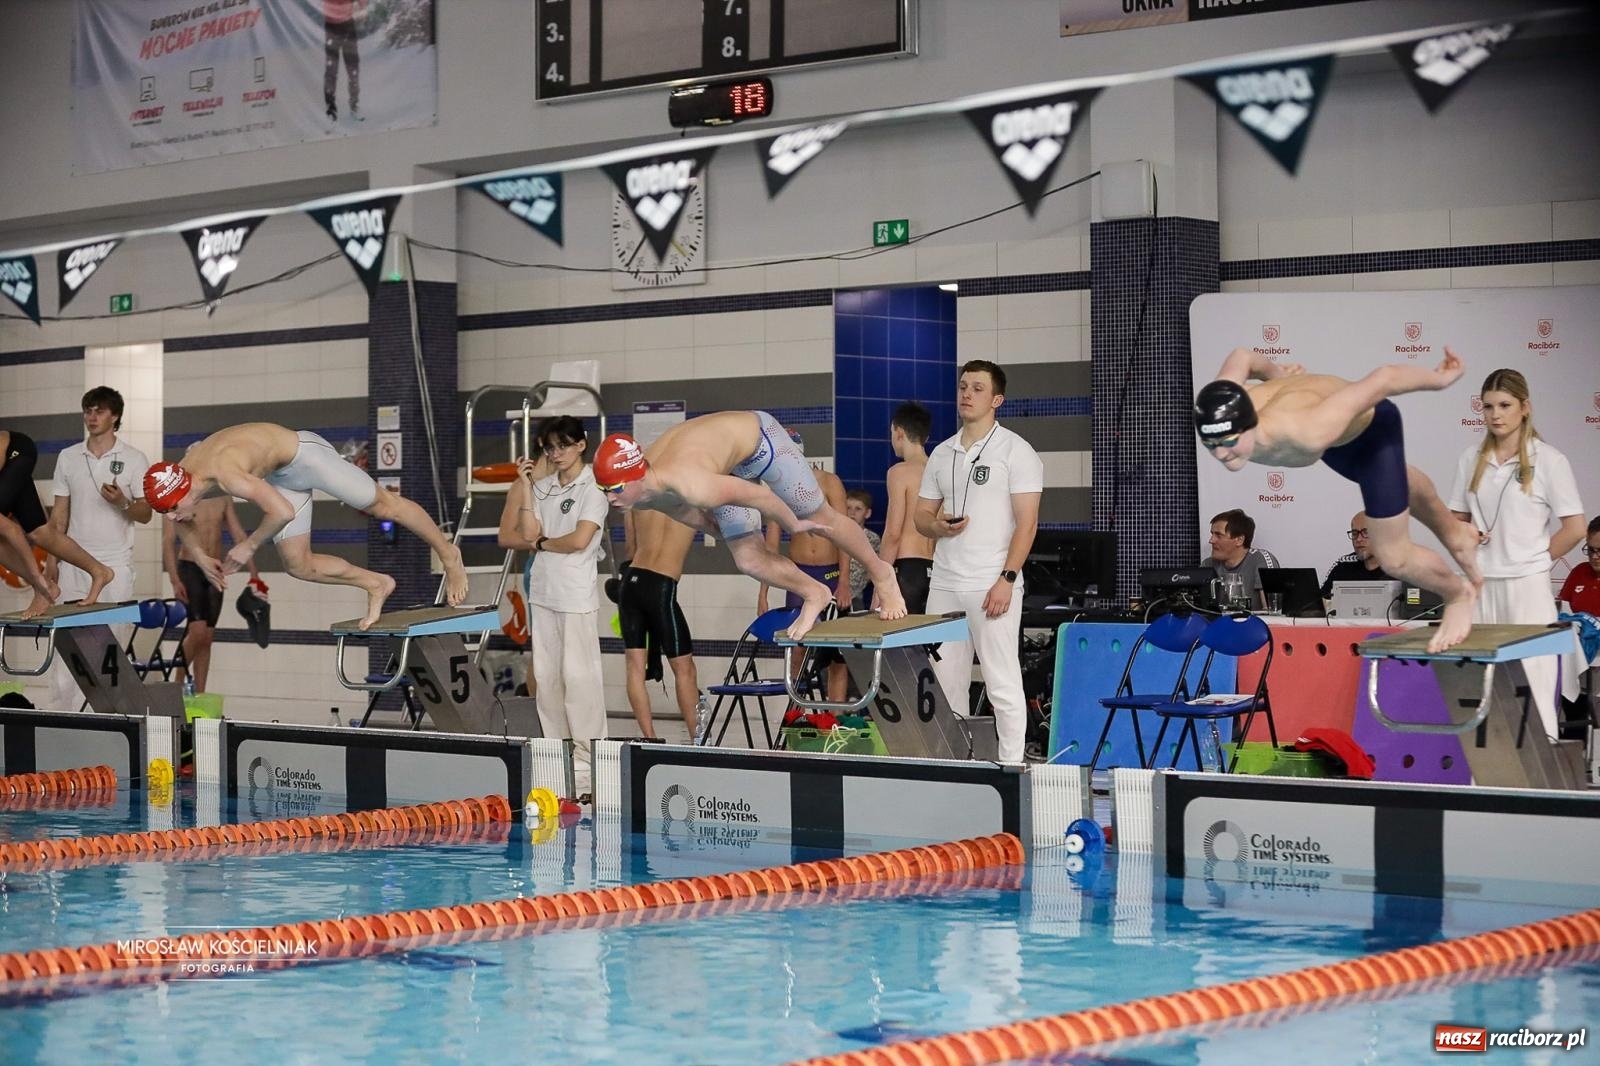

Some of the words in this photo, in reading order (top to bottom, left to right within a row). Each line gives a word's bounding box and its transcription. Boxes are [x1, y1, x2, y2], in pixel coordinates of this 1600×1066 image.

[546, 23, 565, 43] 3.
[722, 36, 742, 58] 8.
[545, 62, 565, 83] 4.
[729, 82, 766, 115] 18
[331, 208, 384, 237] arena
[198, 227, 246, 256] arena
[1395, 345, 1431, 353] Racibórz
[1201, 421, 1232, 434] arena
[1258, 494, 1294, 502] Racibórz
[101, 644, 119, 687] 4
[409, 666, 442, 704] 5
[450, 654, 470, 704] 5
[918, 667, 936, 723] 6
[276, 779, 291, 788] TIME
[698, 809, 719, 820] TIME
[1252, 849, 1279, 861] TIME
